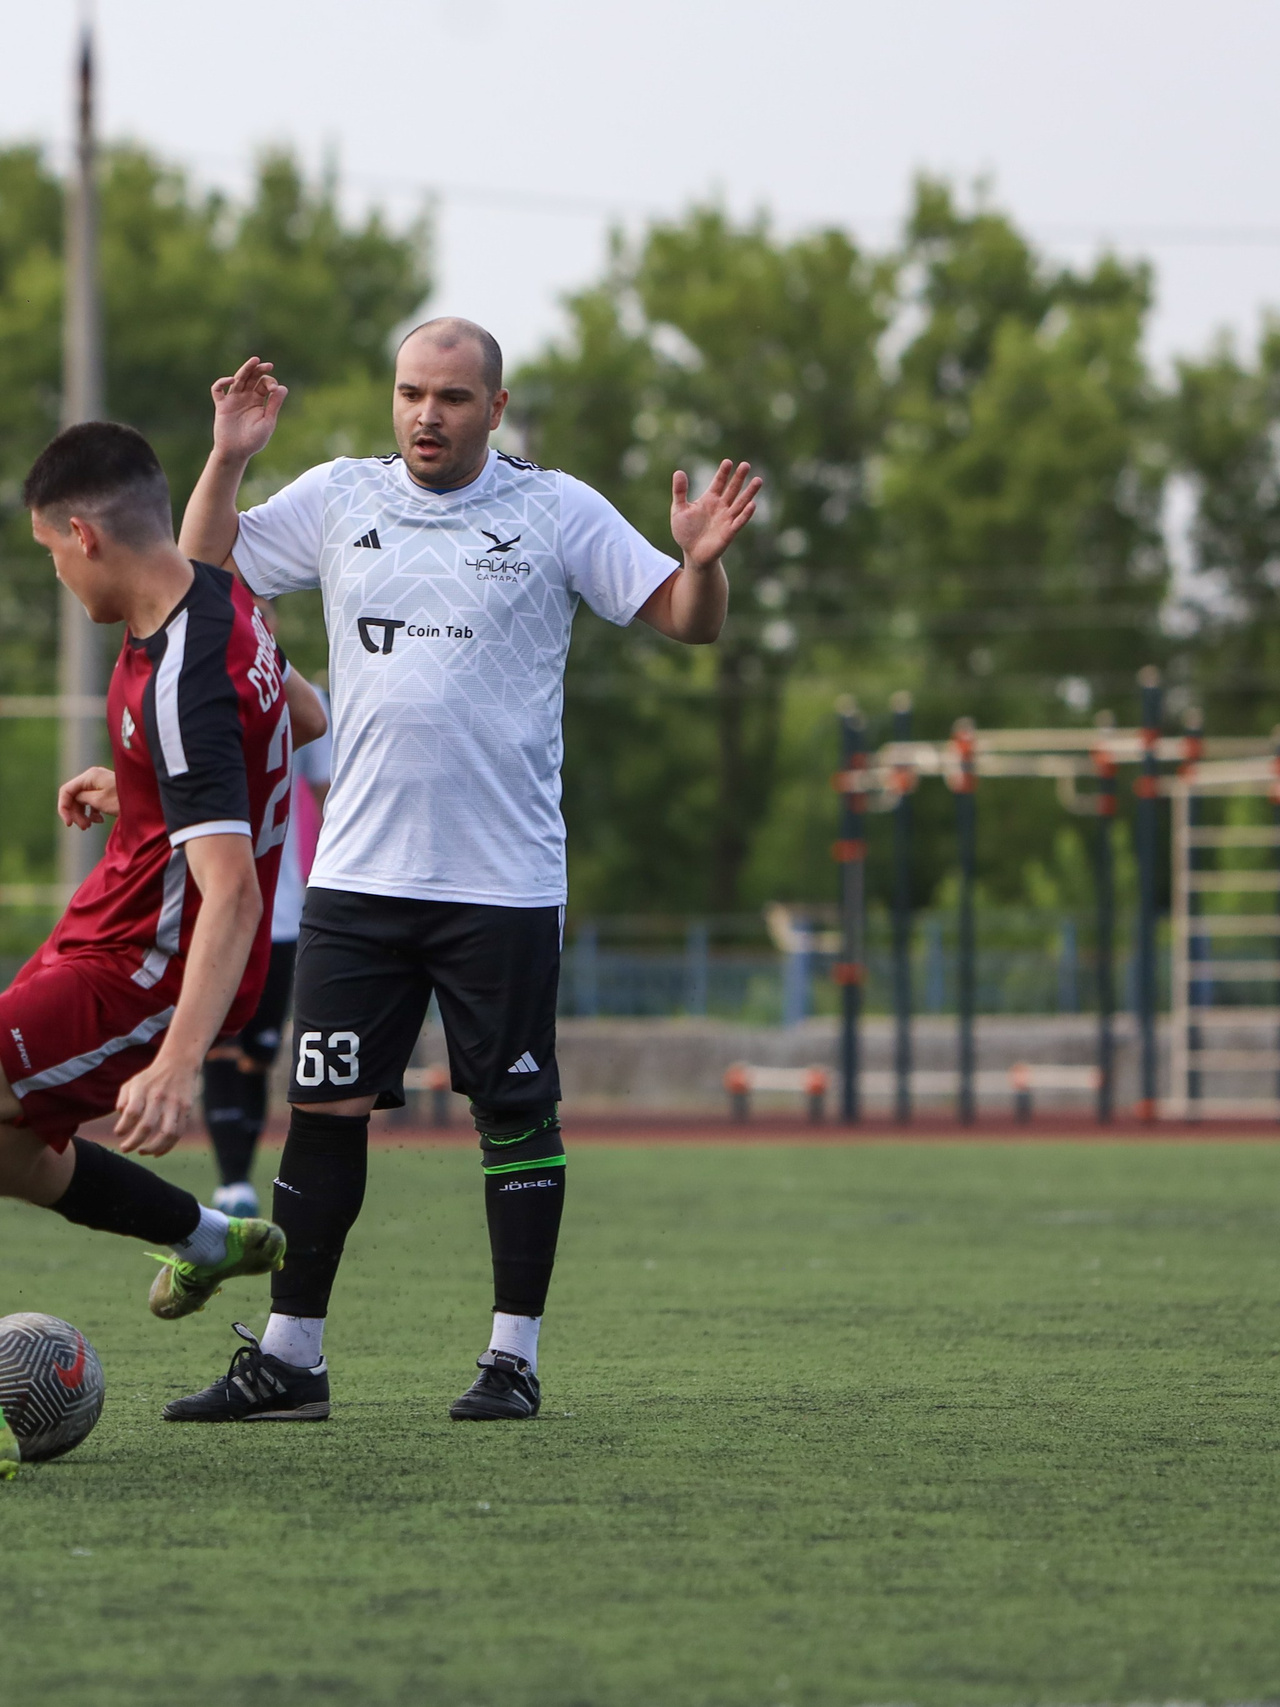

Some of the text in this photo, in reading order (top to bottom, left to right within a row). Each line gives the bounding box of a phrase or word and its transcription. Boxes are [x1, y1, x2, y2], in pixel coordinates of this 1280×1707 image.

[465, 557, 530, 575] ЧАЙКА
[476, 573, 518, 583] САМАРА
[407, 625, 440, 638] Coin
[445, 626, 474, 639] Tab
[295, 1031, 361, 1087] 63
[499, 1179, 558, 1192] JÖGEL
